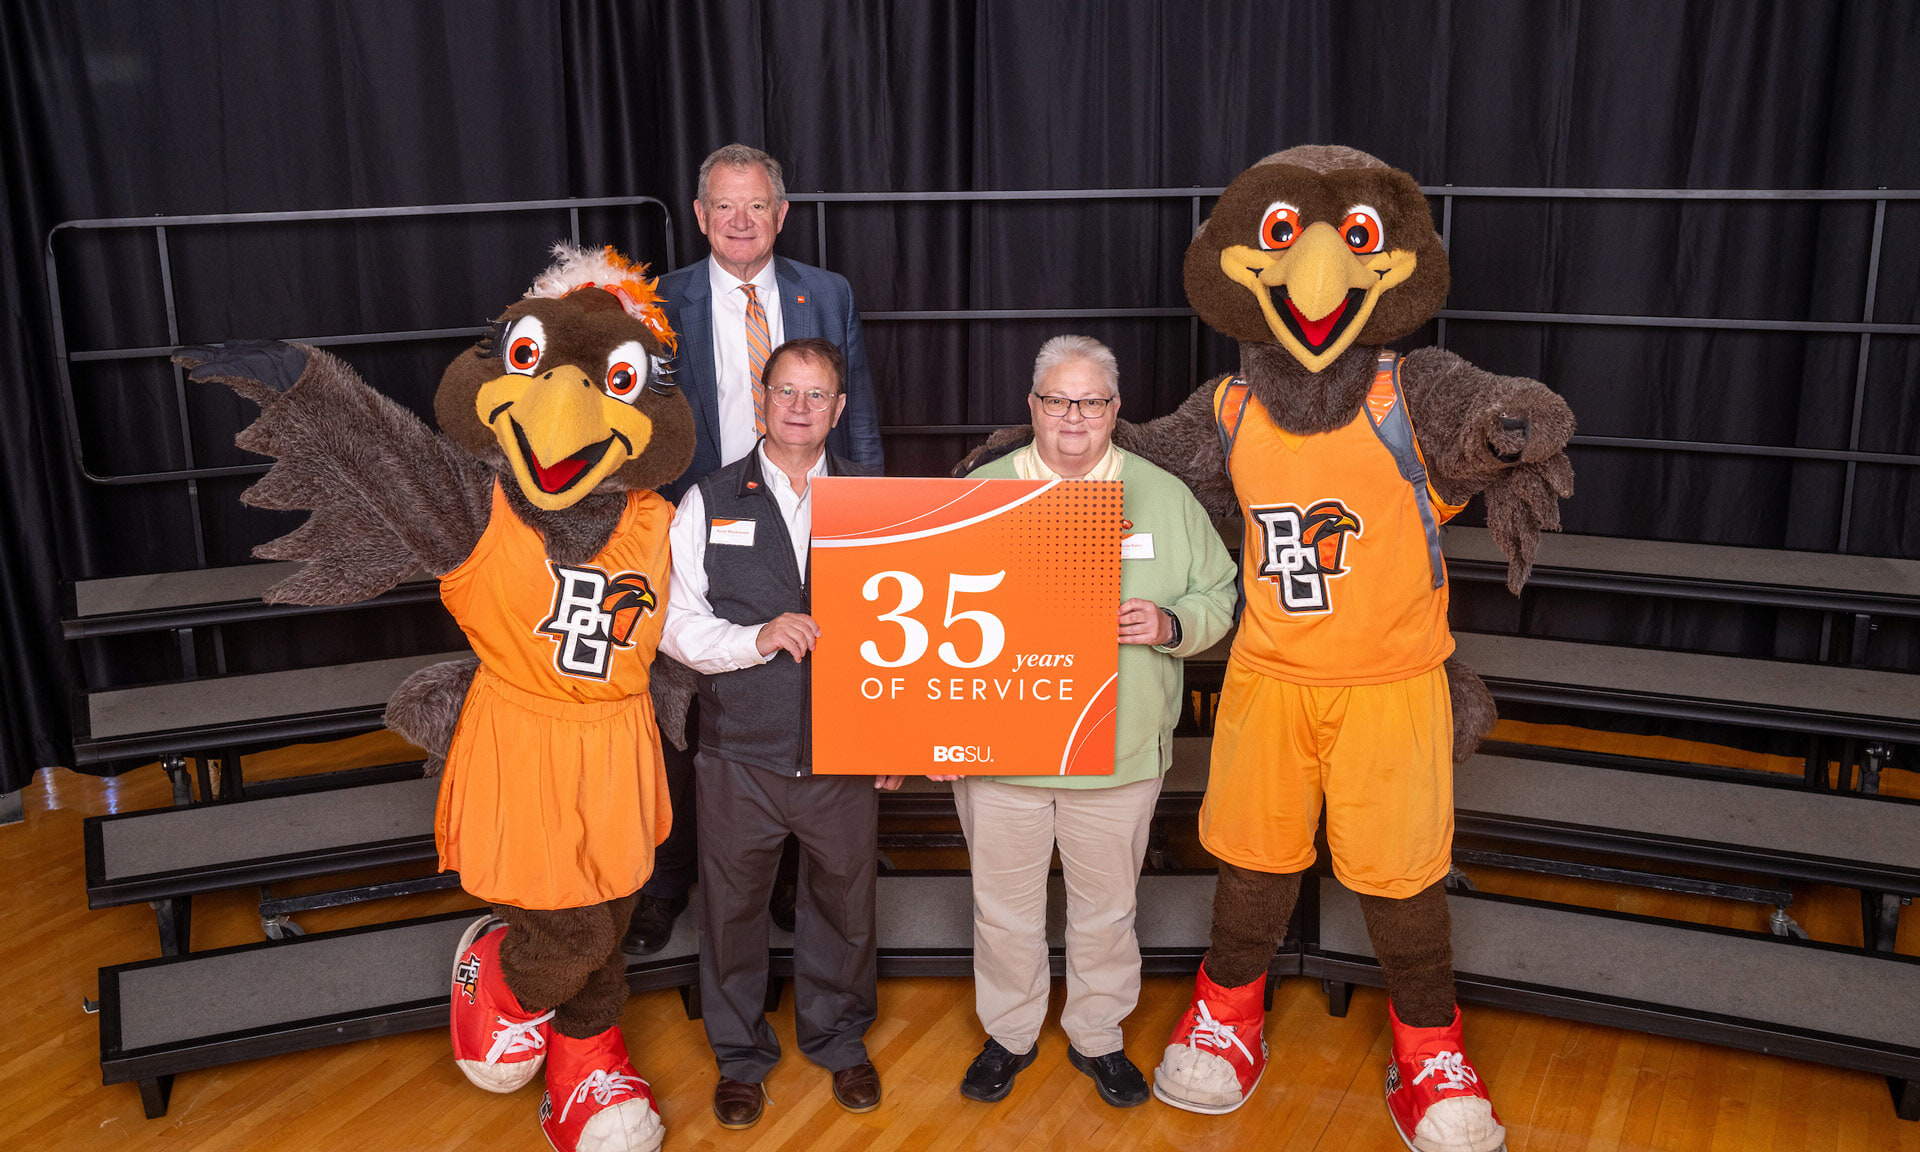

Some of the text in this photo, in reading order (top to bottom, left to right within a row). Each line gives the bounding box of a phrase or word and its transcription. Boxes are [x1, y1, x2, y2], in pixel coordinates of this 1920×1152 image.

[1256, 510, 1324, 608] BG
[547, 566, 613, 675] BG
[860, 569, 1074, 673] 35 years
[860, 677, 1074, 701] OF SERVICE
[933, 745, 991, 763] BGSU
